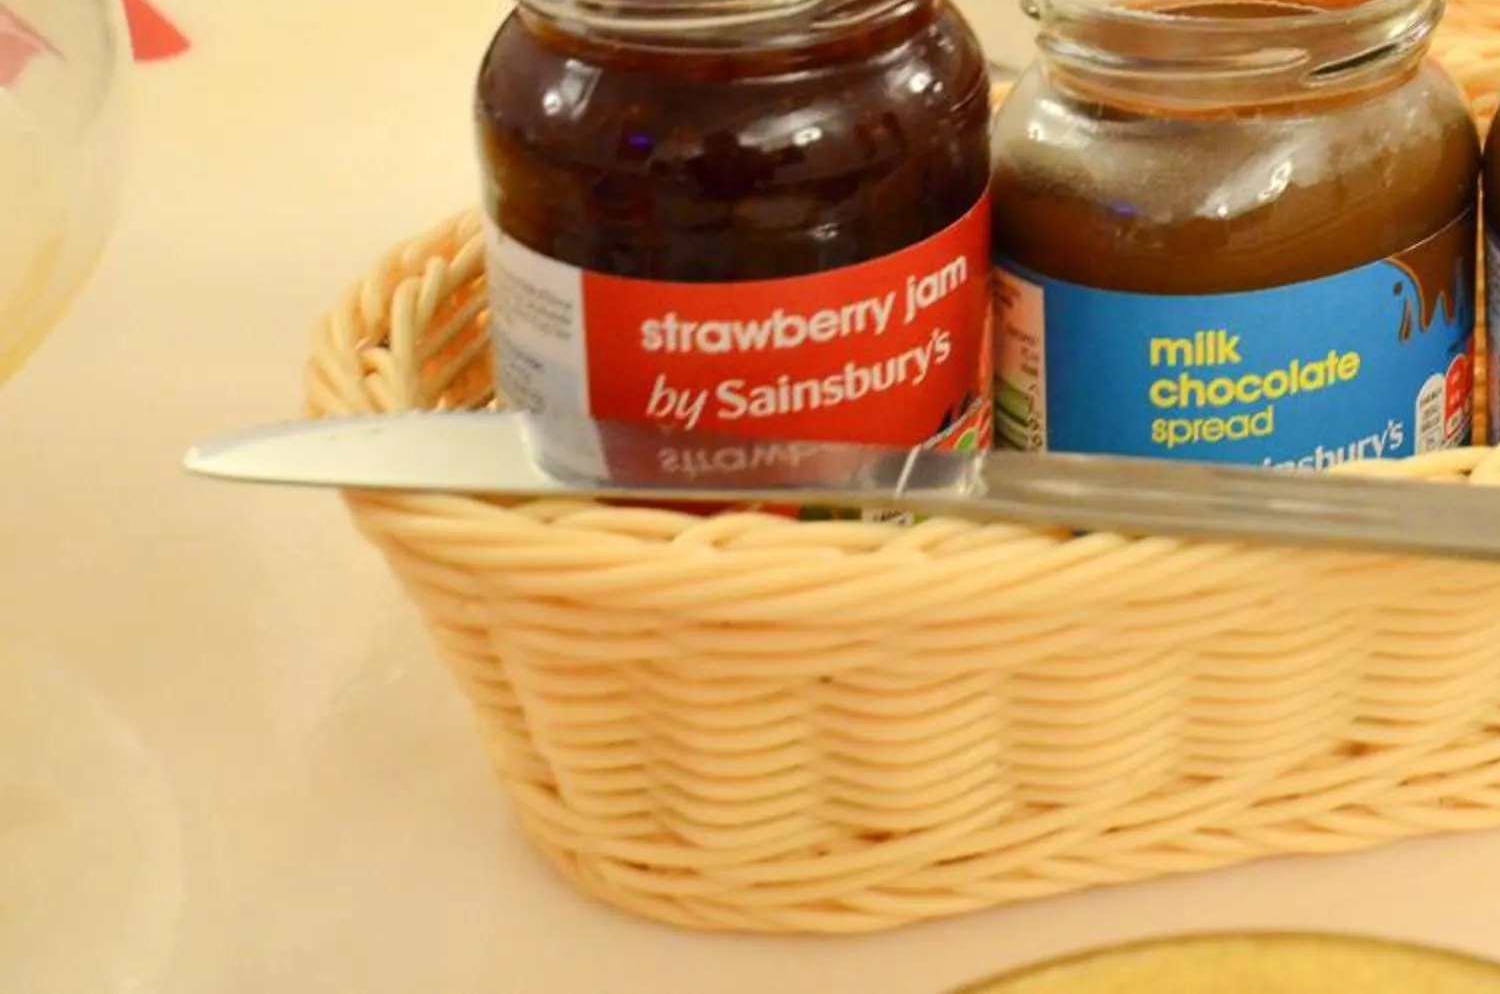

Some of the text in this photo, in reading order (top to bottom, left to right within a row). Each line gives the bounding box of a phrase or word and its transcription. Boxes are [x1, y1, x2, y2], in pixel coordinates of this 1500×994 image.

[639, 291, 897, 353] strawberry
[903, 254, 968, 324] jam
[1149, 328, 1242, 368] milk
[646, 374, 708, 430] by
[717, 327, 952, 420] Sainsbury's
[1148, 350, 1361, 408] chocolate
[1151, 406, 1275, 449] spread
